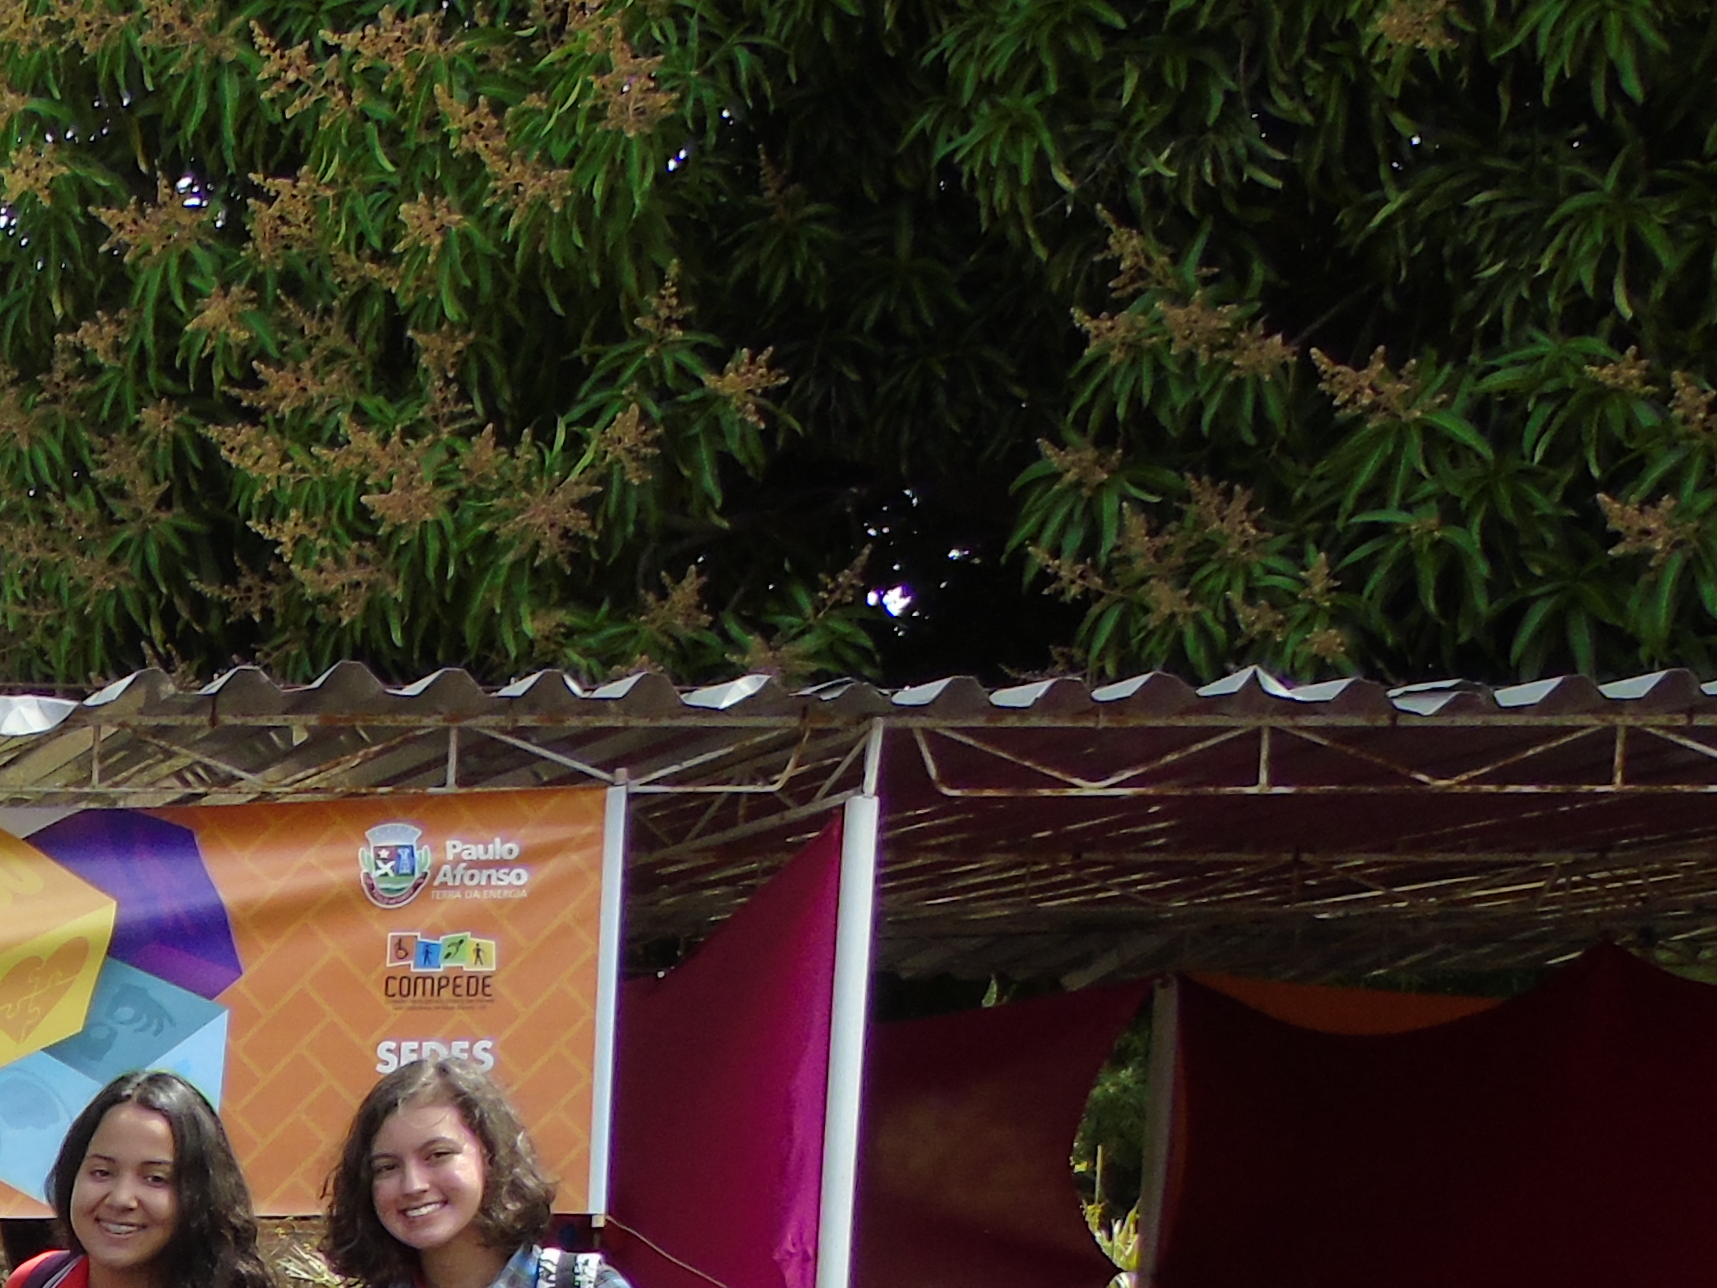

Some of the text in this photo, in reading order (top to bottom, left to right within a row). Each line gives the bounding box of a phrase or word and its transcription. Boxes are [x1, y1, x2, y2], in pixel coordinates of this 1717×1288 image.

[445, 837, 521, 861] Paulo
[433, 863, 529, 887] Afonso
[384, 974, 494, 998] COMPEDE
